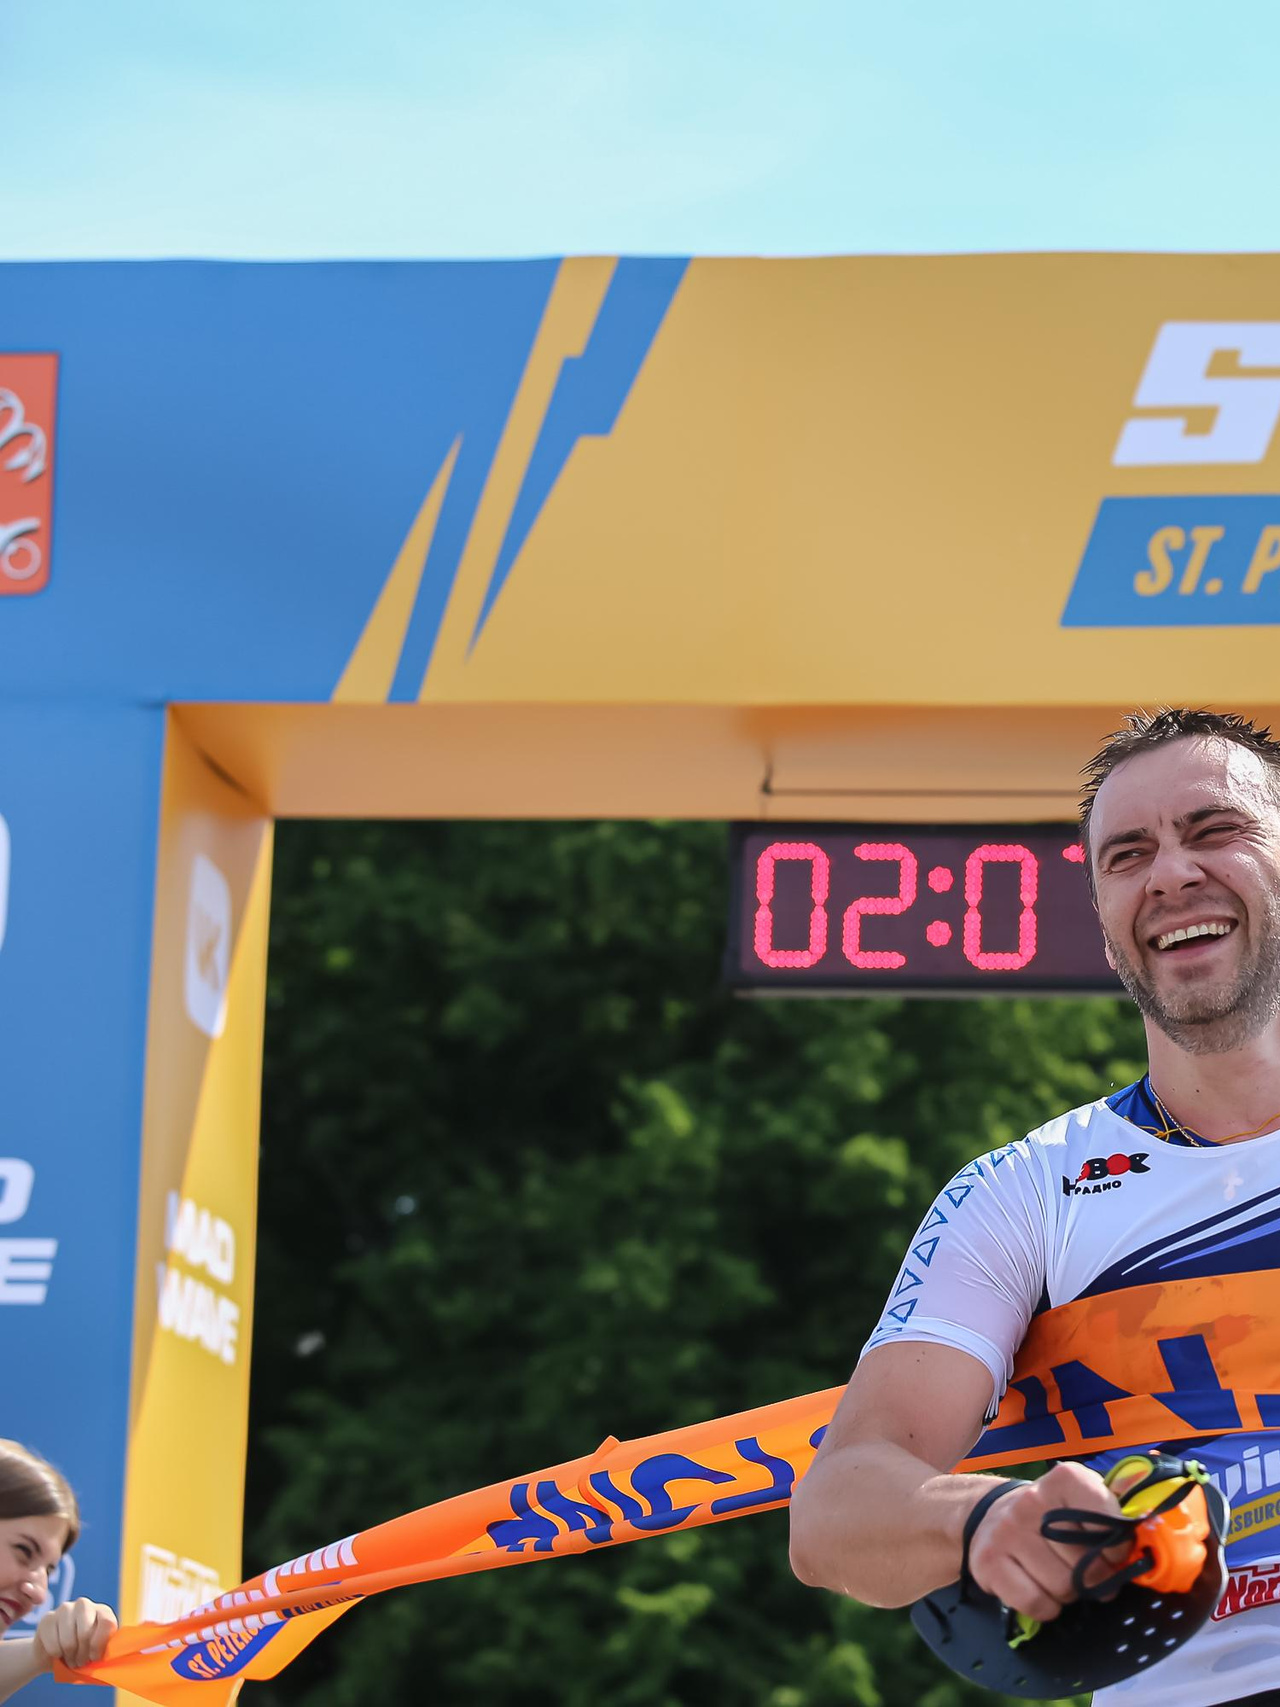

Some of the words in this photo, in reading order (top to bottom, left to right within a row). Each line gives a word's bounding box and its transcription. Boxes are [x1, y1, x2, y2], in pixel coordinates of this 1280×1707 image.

[1133, 524, 1226, 596] ST.
[753, 841, 1086, 971] 02:0
[1074, 1179, 1123, 1196] РАДИО
